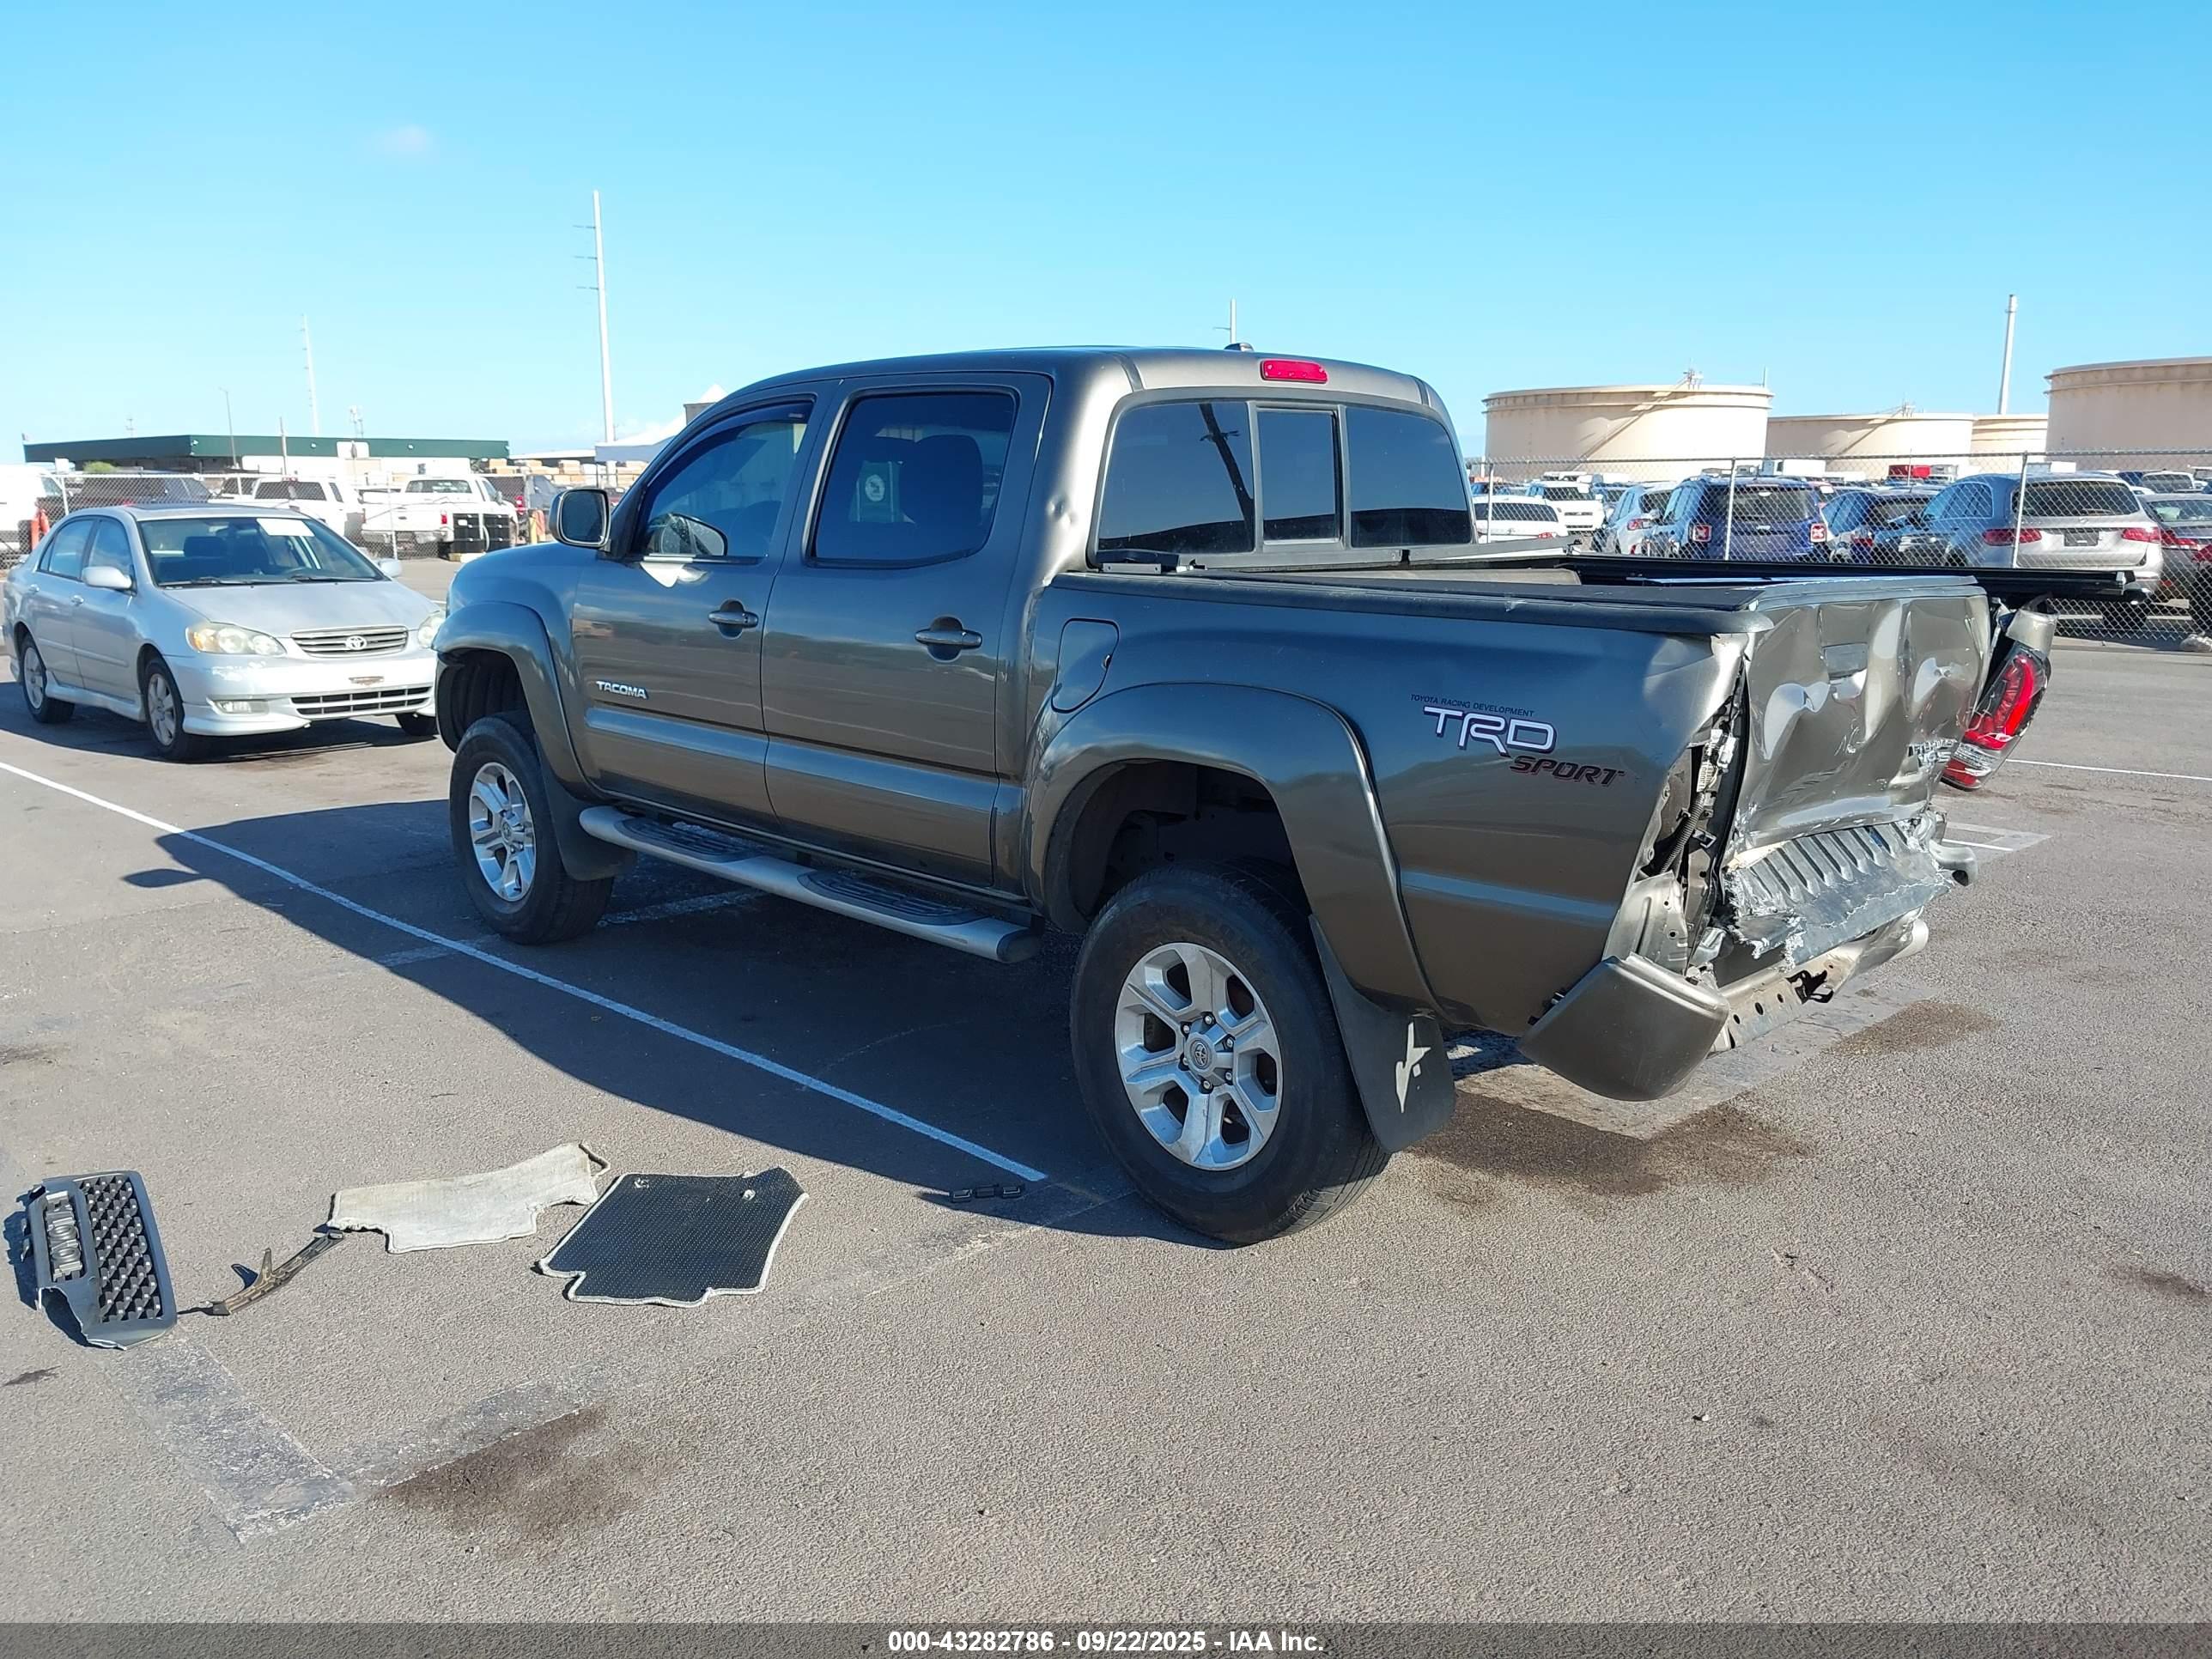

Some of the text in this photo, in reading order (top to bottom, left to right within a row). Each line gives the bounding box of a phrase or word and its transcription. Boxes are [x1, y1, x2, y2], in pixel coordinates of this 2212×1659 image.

[595, 680, 648, 699] TACOMA
[1410, 694, 1534, 717] TOYOTA RACING DEVELOPMENT
[1423, 704, 1557, 757] TRD
[1510, 756, 1626, 787] SPORT
